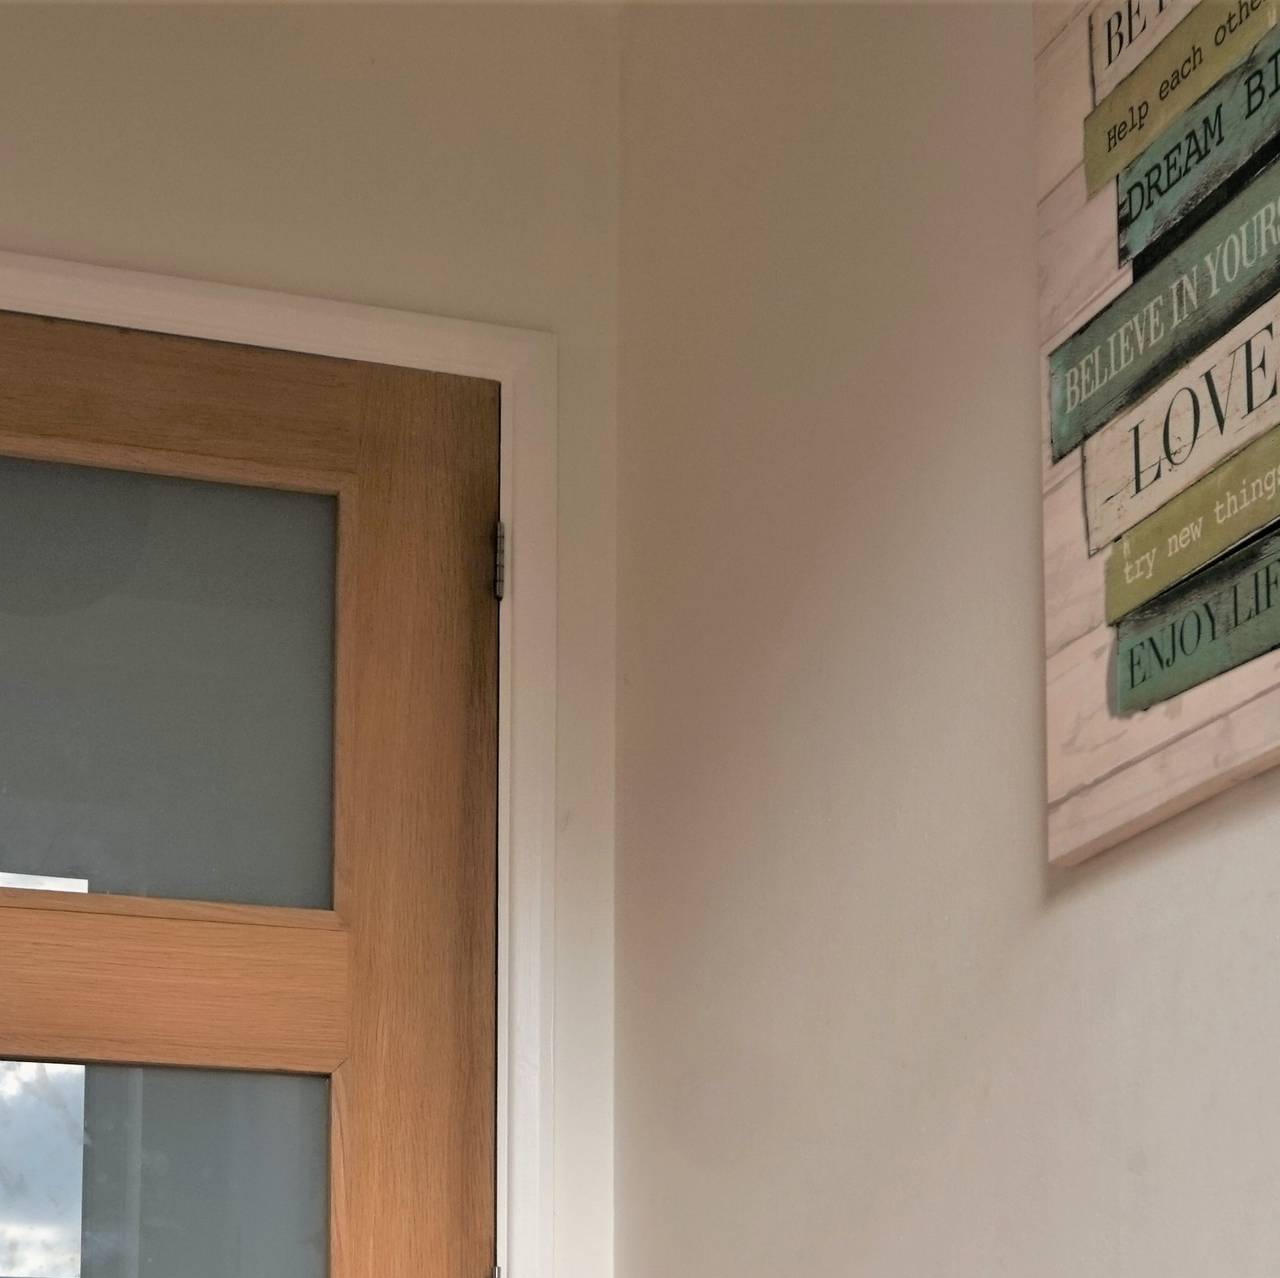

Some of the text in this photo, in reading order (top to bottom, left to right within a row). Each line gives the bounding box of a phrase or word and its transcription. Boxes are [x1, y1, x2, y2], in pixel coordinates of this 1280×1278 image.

[1104, 0, 1147, 69] BE
[1107, 0, 1267, 152] Help each othe
[1125, 104, 1224, 224] DREAM
[1065, 295, 1166, 415] BELIEVE
[1170, 263, 1200, 329] IN
[1128, 324, 1278, 498] LOVE
[1123, 549, 1156, 585] try
[1167, 516, 1203, 559] new
[1127, 601, 1218, 689] ENJOY
